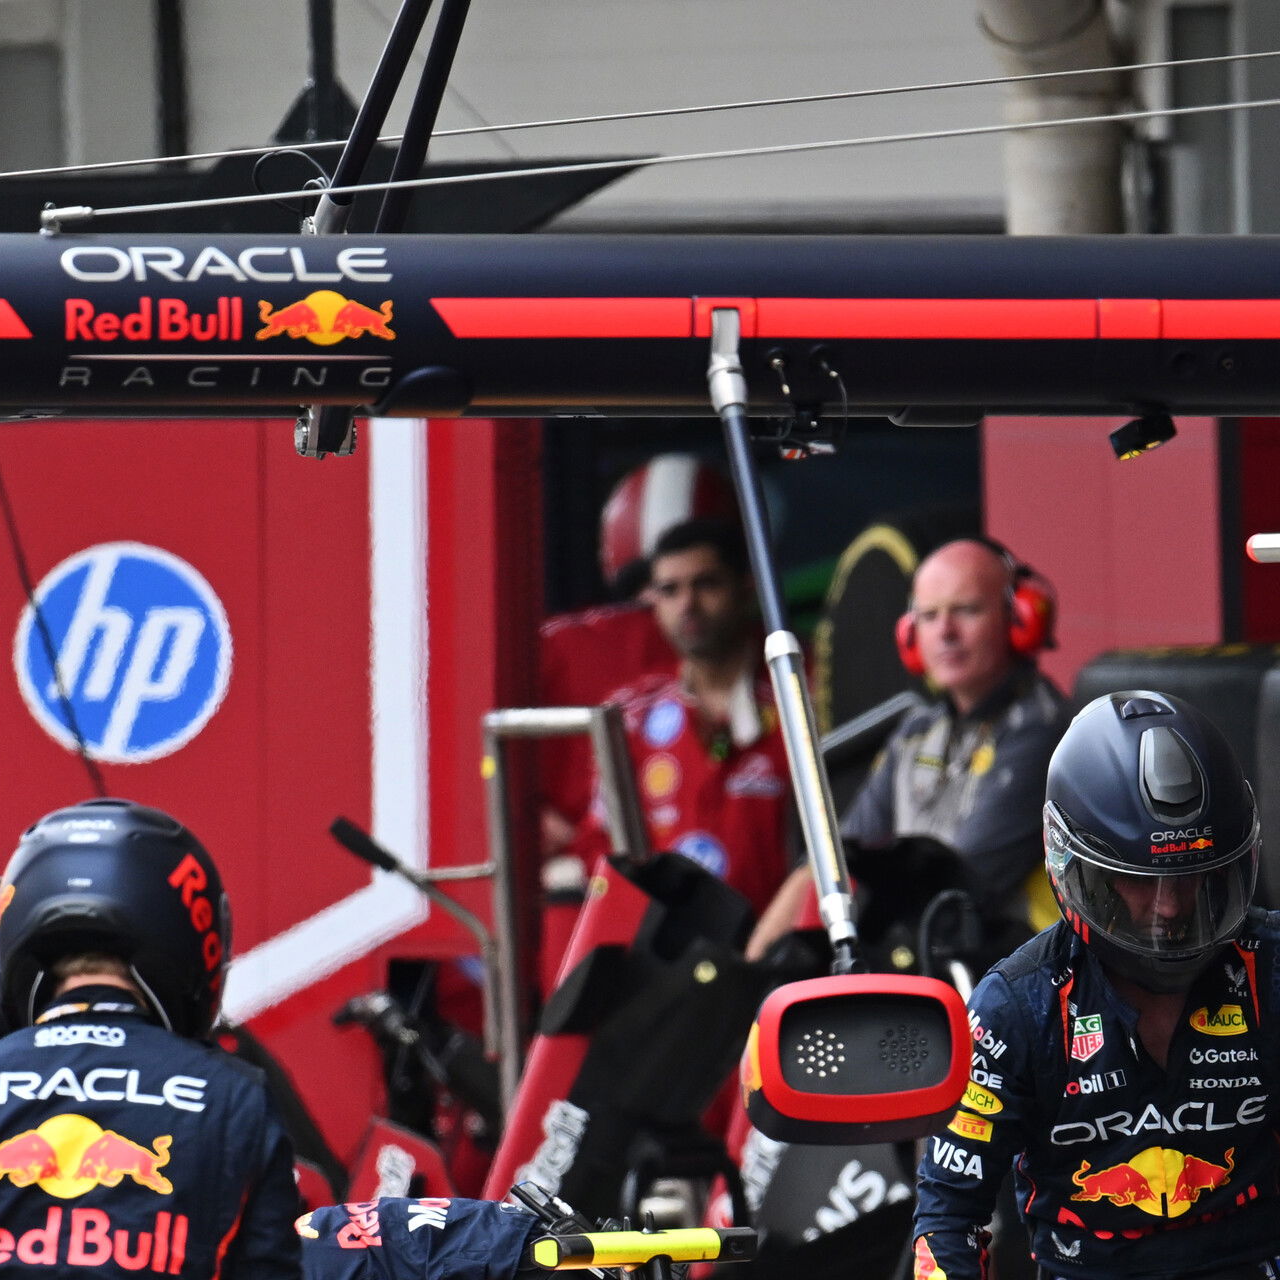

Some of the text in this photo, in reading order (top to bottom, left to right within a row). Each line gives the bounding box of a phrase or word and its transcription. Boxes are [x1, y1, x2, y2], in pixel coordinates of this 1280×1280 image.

[60, 246, 393, 283] ORACLE
[65, 297, 242, 341] Red Bull
[60, 367, 392, 386] RACING
[48, 548, 206, 753] hp
[1150, 826, 1214, 842] ORACLE
[34, 1025, 126, 1047] sparco
[1073, 1018, 1100, 1033] AG
[1072, 1034, 1104, 1057] EUER
[1063, 1074, 1104, 1098] obil
[1189, 1076, 1262, 1089] HONDA
[966, 1089, 995, 1109] AUCH
[1050, 1095, 1269, 1146] ORACLE
[932, 1136, 983, 1180] VISA
[68, 1208, 189, 1275] Bull
